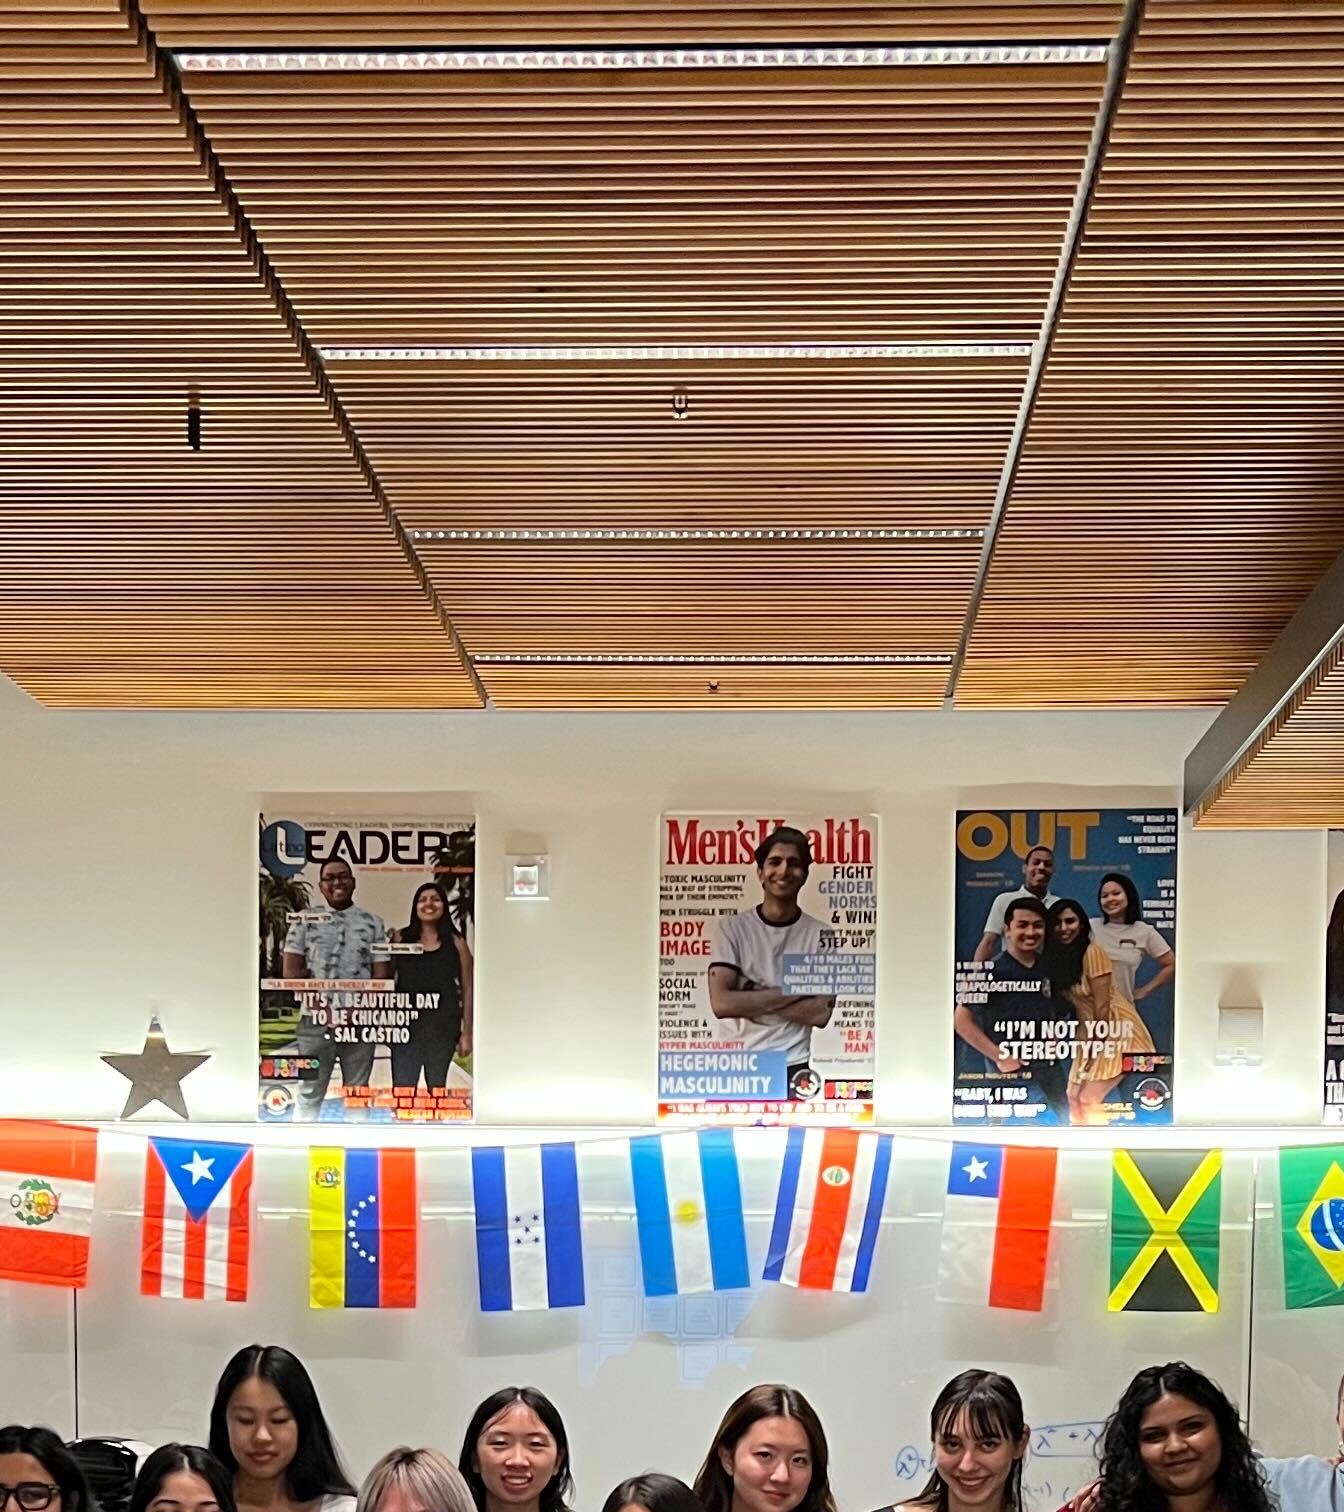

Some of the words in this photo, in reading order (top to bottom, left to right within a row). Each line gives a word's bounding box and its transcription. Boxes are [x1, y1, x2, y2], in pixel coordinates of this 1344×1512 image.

[666, 819, 755, 864] Men's
[756, 818, 872, 864] alth
[957, 812, 1100, 861] OUT
[277, 826, 474, 865] LEADER
[833, 866, 873, 879] FIGHT
[819, 882, 873, 894] GENDER
[829, 896, 877, 908] NORMS
[831, 911, 840, 923] &
[846, 911, 877, 923] WIN!
[661, 922, 704, 937] BODY
[661, 941, 711, 955] IMAGE
[820, 938, 847, 948] STEP
[851, 938, 871, 948] UP!
[659, 978, 697, 989] SOCIAL
[784, 975, 825, 984] QUALITIES
[956, 981, 1041, 993] UNAPOLOGETICALLY
[330, 992, 341, 1009] A
[345, 992, 412, 1009] BEAUTIFUL
[416, 992, 440, 1009] DAY
[659, 991, 690, 1001] NORM
[312, 1010, 327, 1026] TO
[332, 1010, 347, 1026] BE
[335, 1027, 358, 1043] SAL
[361, 1027, 409, 1043] CASTRO
[866, 1030, 874, 1041] A
[1042, 1021, 1078, 1039] NOT
[1085, 1021, 1134, 1039] YOUR
[660, 1055, 757, 1072] HEGEMONIC
[1326, 1060, 1337, 1080] A
[661, 1077, 771, 1094] MASCULINITY
